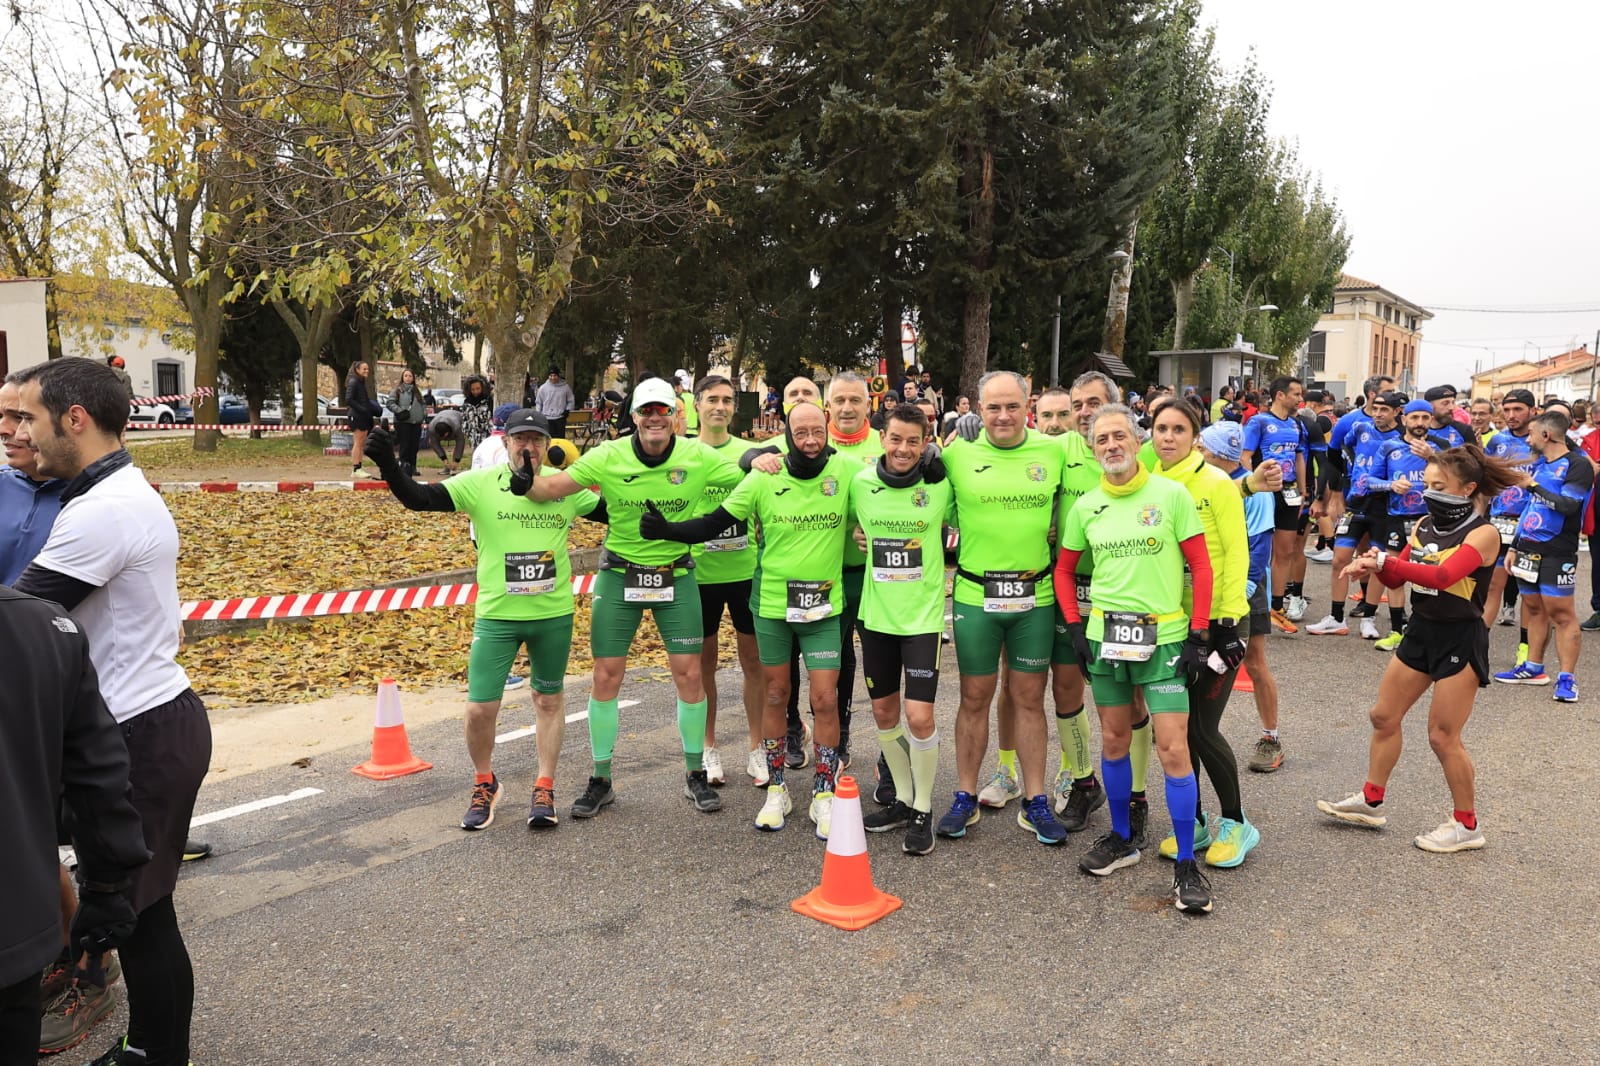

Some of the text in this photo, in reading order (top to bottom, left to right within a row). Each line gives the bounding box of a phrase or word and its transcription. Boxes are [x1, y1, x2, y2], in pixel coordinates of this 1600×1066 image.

[618, 498, 683, 507] SANMXIMO
[980, 493, 1045, 504] SANMAXIMO
[1003, 502, 1040, 511] TELECOM
[497, 511, 563, 522] SANMAXIMO
[772, 511, 837, 524] SANMAXIMO
[520, 520, 559, 529] TELECOM
[794, 522, 834, 532] TELECOM
[869, 519, 924, 528] SANMAXIMO
[718, 523, 738, 538] 91
[887, 526, 920, 534] TELECOM
[884, 551, 910, 567] 181
[1109, 547, 1152, 559] TELECOM
[1518, 557, 1533, 571] 231
[517, 563, 546, 580] 187
[636, 573, 663, 587] 189
[1557, 574, 1576, 585] MS
[995, 582, 1025, 597] 183
[1075, 585, 1091, 601] 85
[797, 592, 822, 608] 182
[1113, 624, 1145, 643] 190
